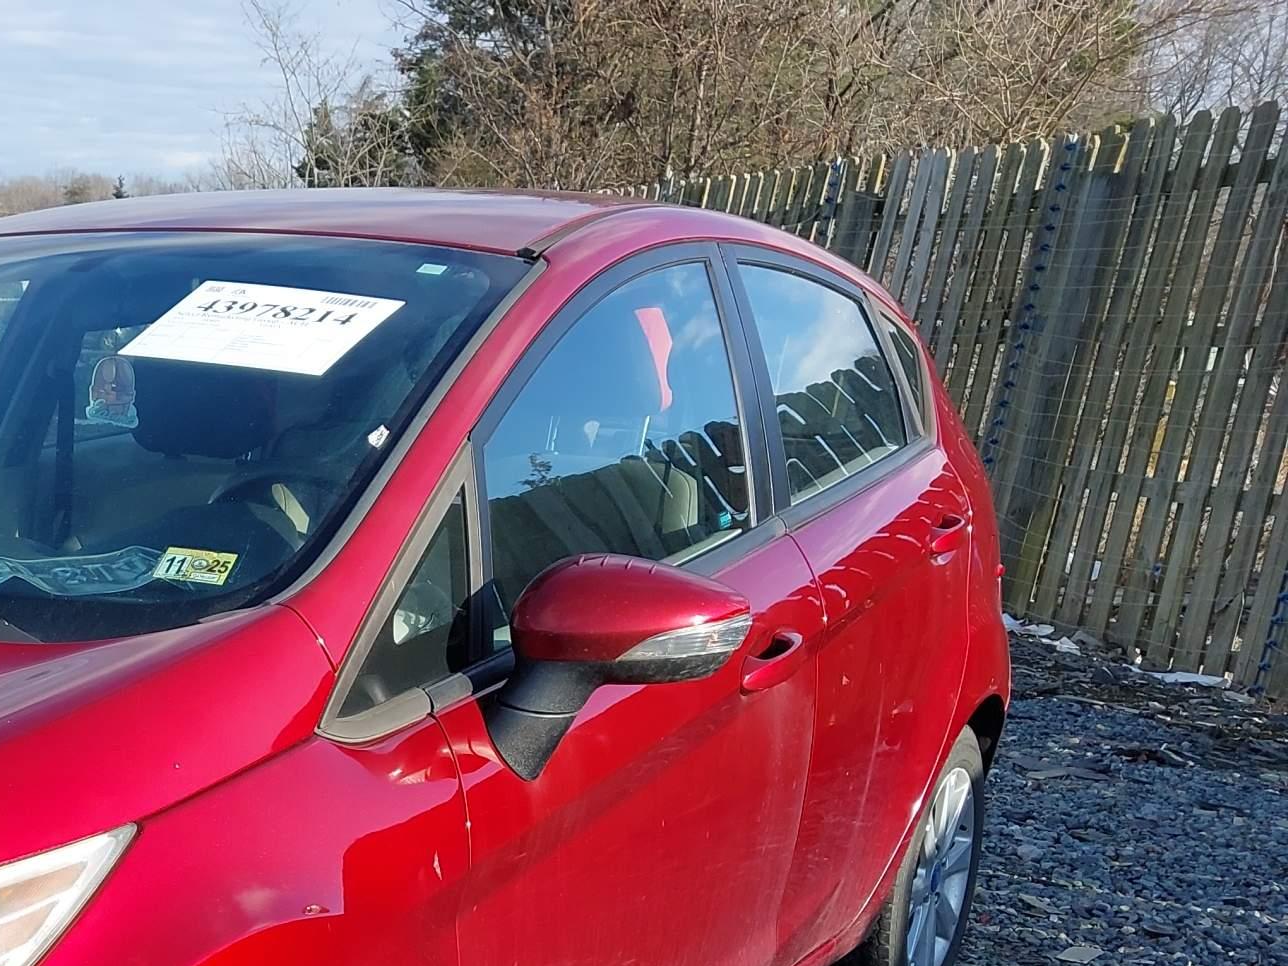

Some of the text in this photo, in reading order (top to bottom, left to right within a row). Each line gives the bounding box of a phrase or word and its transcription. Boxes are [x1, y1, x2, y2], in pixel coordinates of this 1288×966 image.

[196, 298, 360, 326] 43978214
[165, 556, 188, 575] 11
[206, 559, 232, 574] 25
